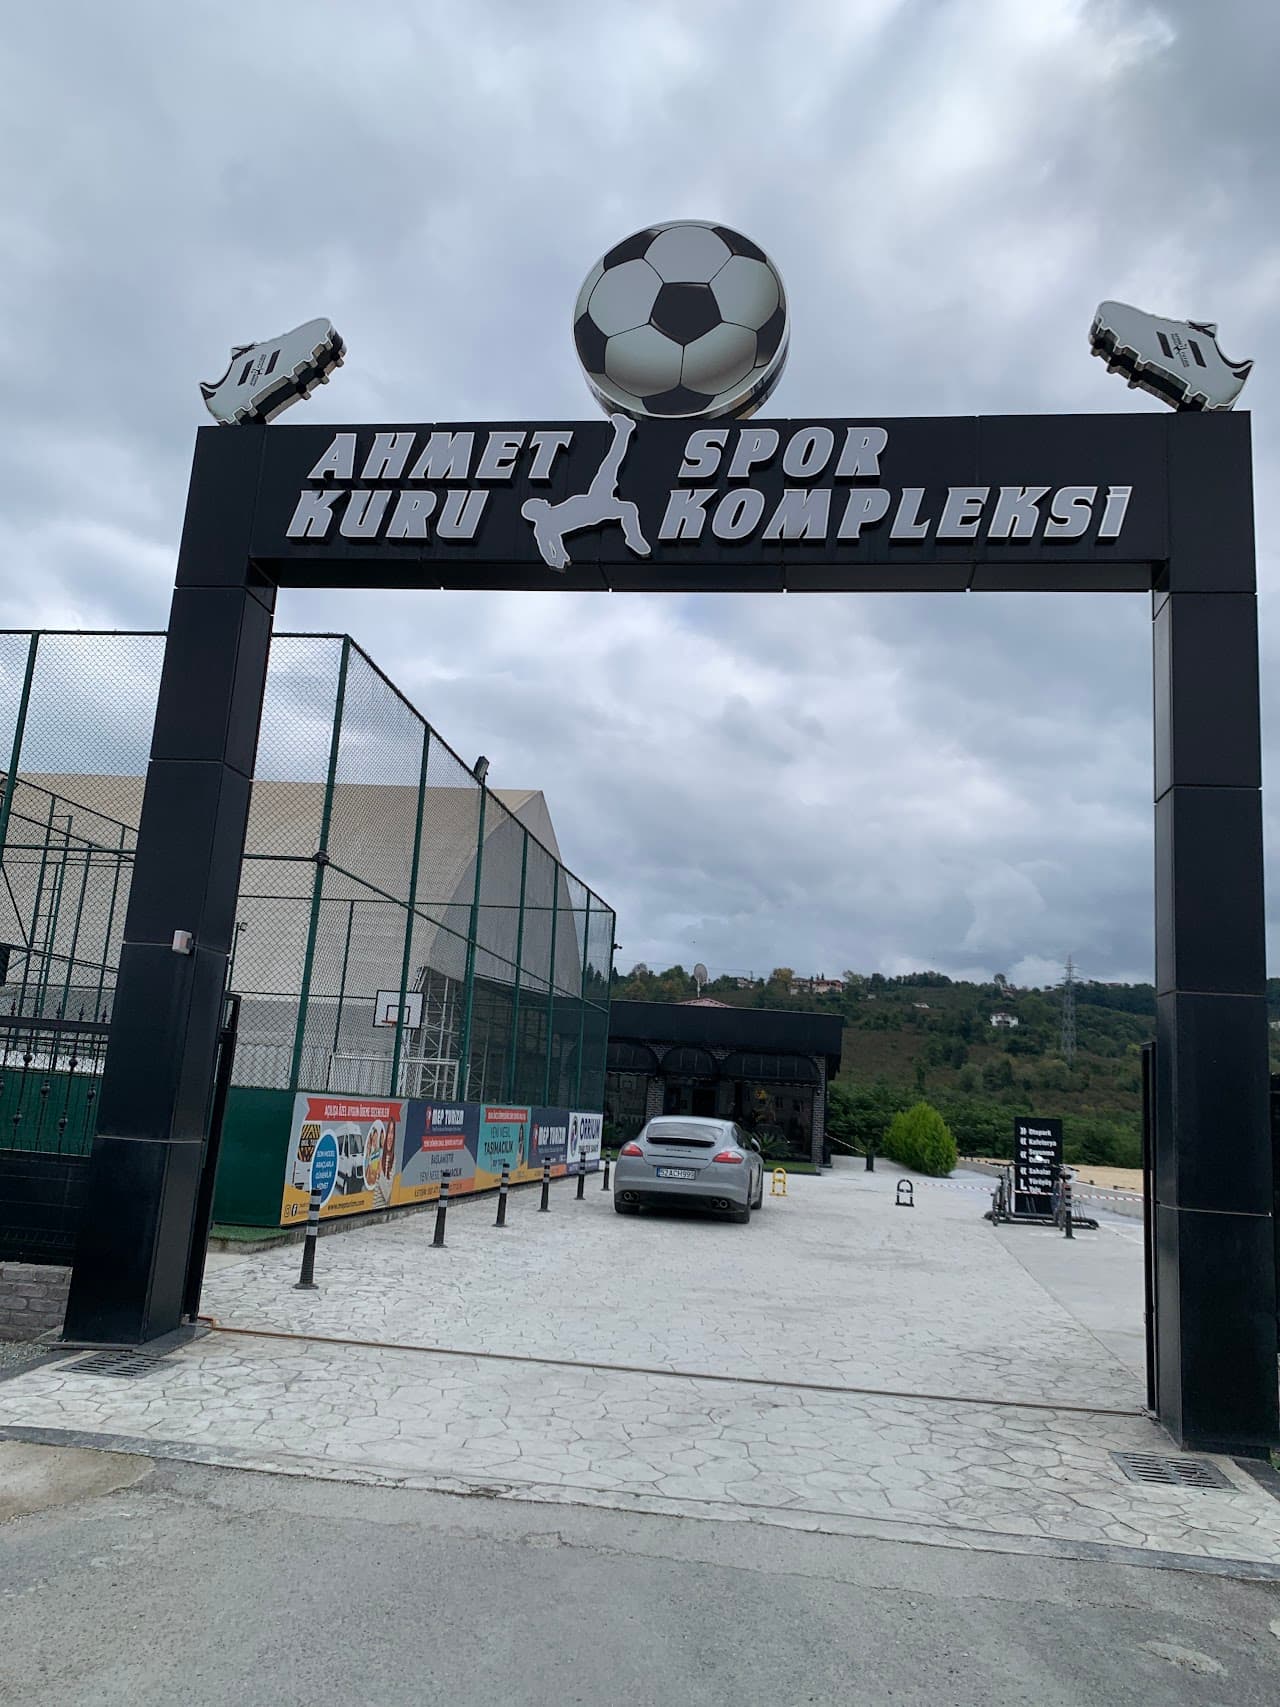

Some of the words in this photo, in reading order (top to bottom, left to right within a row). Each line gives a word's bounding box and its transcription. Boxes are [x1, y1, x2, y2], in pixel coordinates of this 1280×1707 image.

[306, 430, 575, 481] AHMET
[676, 426, 889, 479] SPOR
[285, 489, 490, 540] KURU
[1028, 1128, 1052, 1137] Otopark
